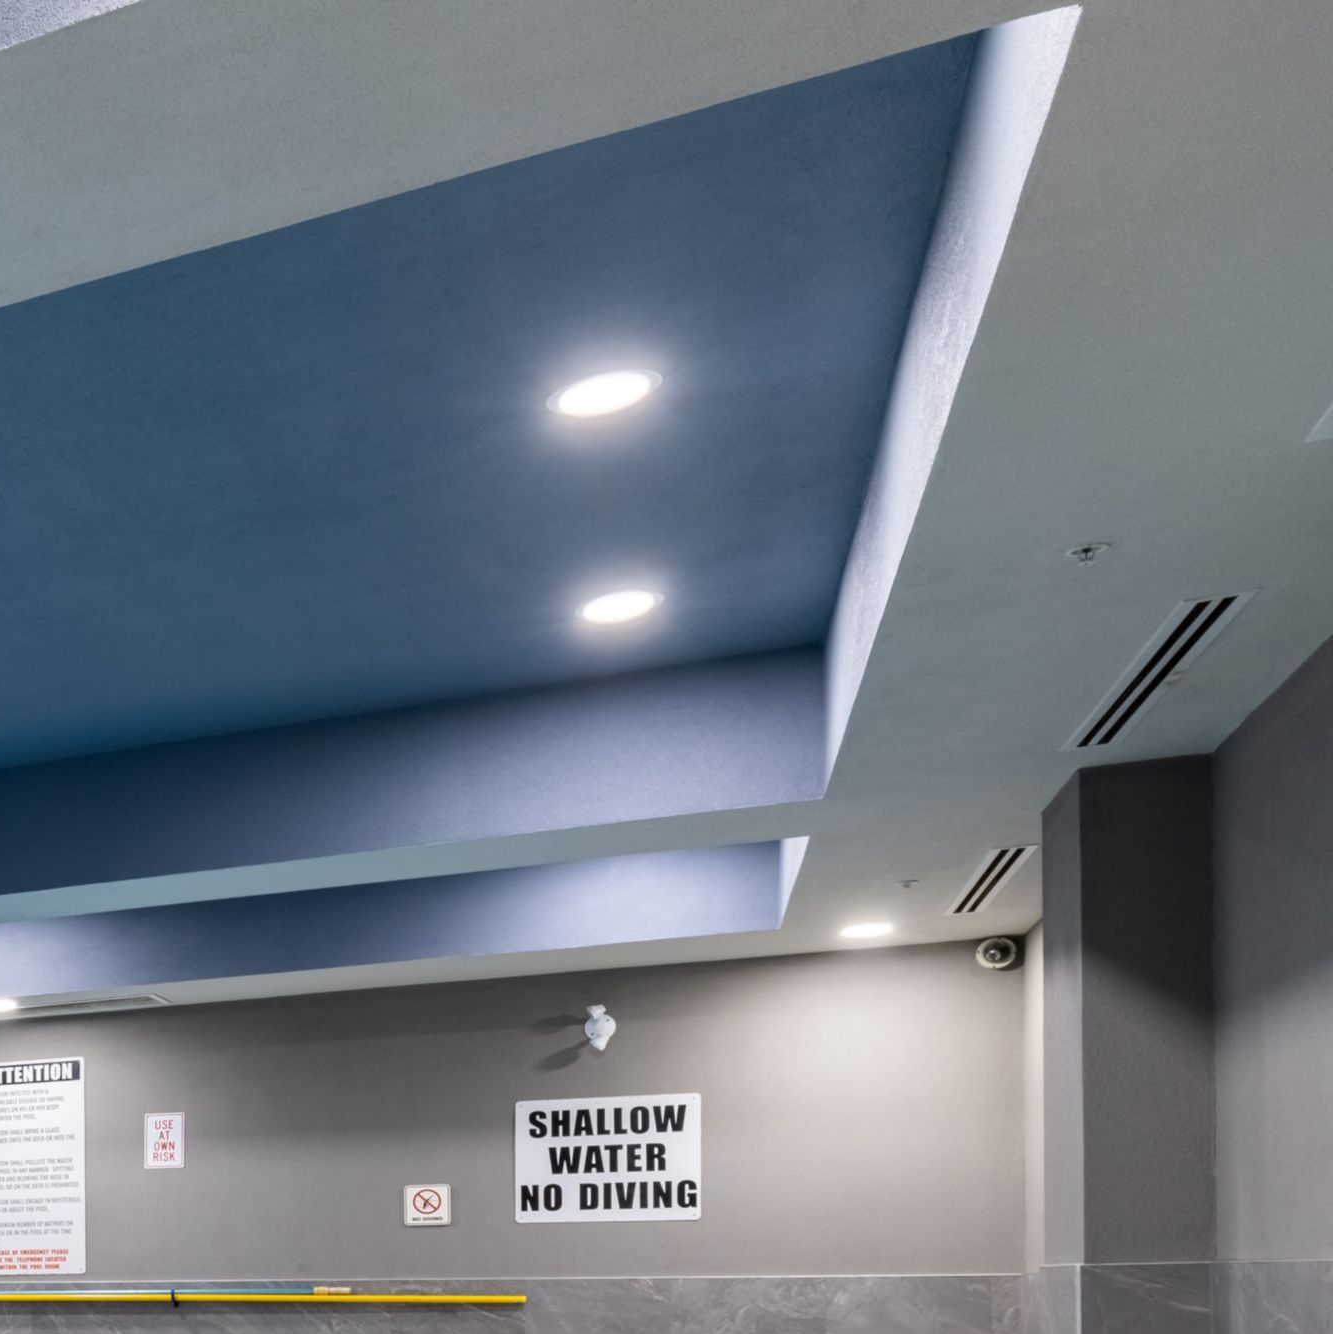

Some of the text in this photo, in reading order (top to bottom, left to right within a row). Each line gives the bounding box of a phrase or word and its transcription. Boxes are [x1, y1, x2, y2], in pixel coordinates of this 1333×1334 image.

[155, 1120, 173, 1130] USE
[528, 1105, 686, 1138] SHALLOW
[159, 1130, 170, 1140] AT
[154, 1141, 175, 1151] OWN
[153, 1152, 175, 1161] RISK
[549, 1143, 666, 1174] WATER
[521, 1180, 697, 1212] NO DIVING
